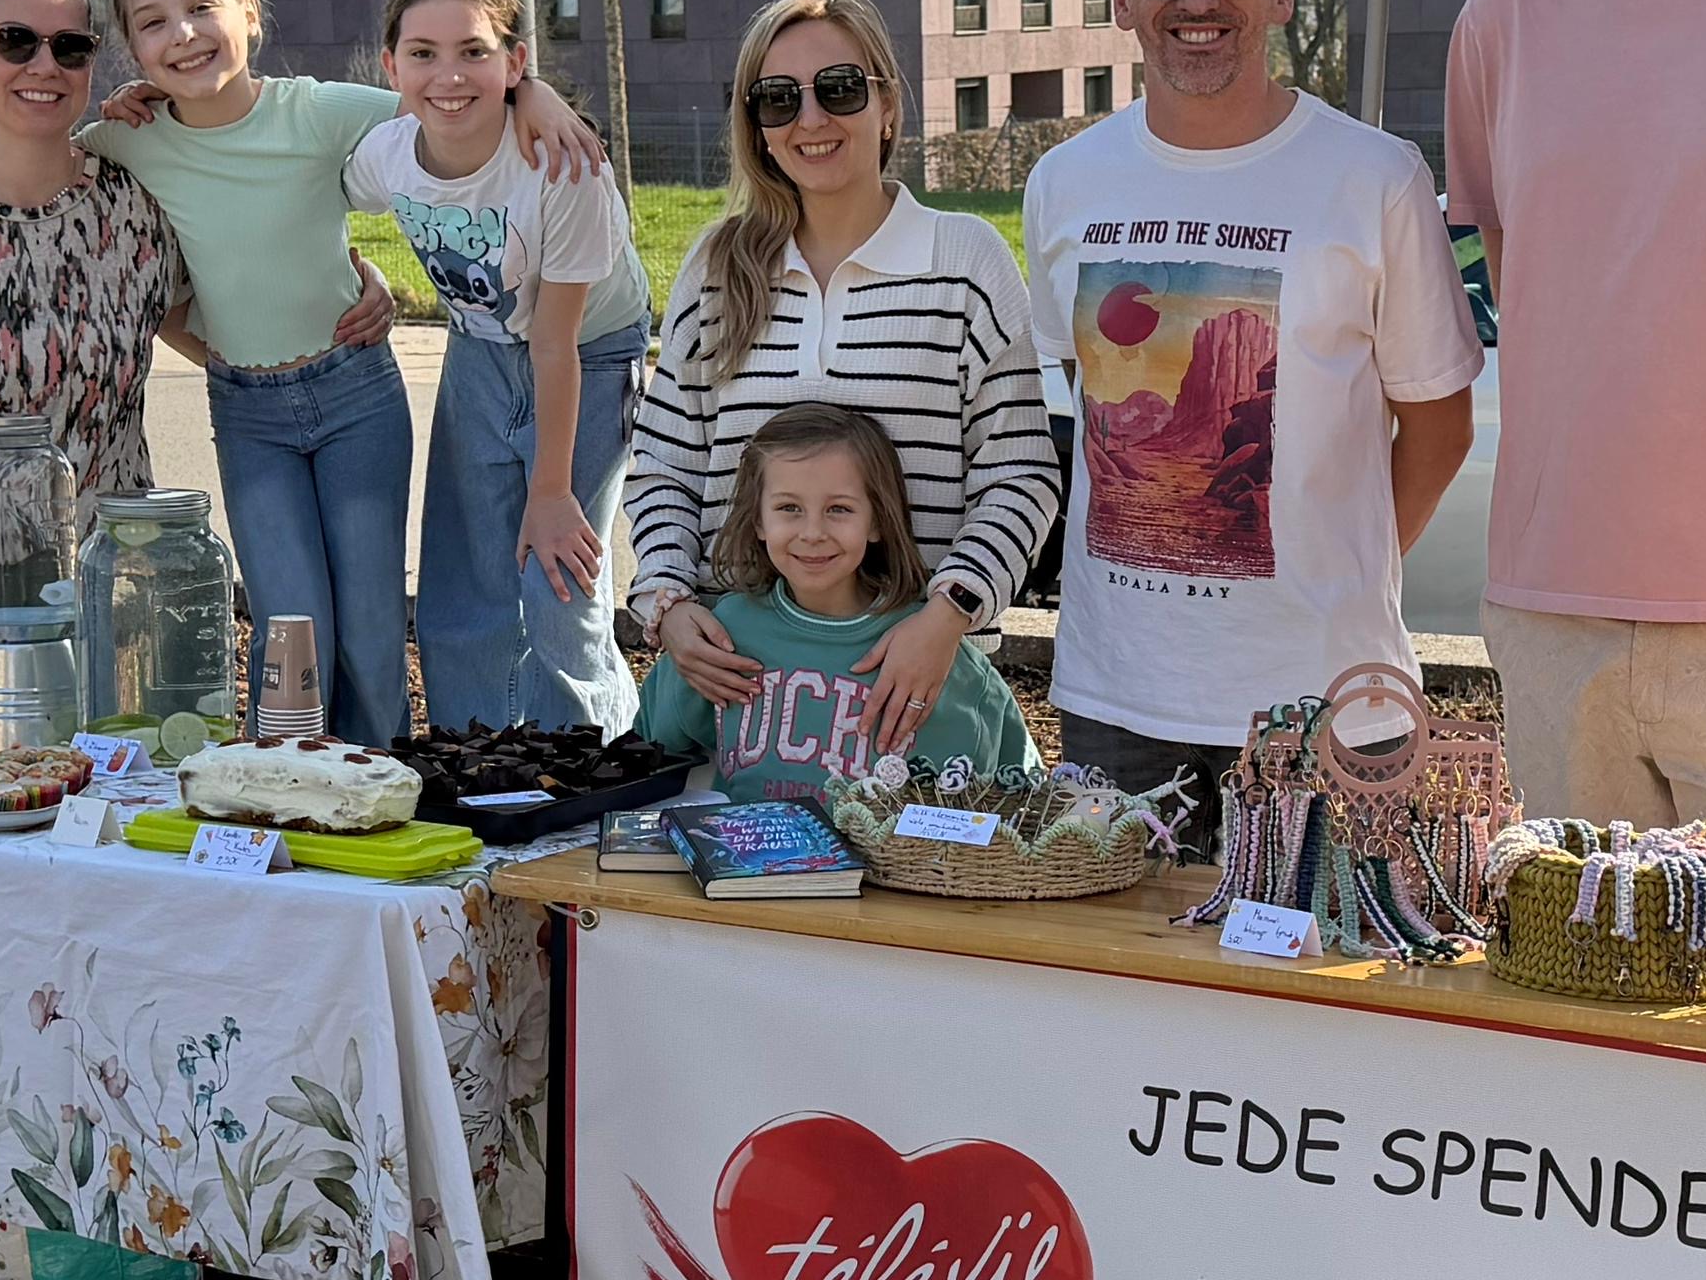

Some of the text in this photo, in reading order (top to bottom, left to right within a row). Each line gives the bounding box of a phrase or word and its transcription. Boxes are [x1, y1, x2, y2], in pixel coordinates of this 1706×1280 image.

[1082, 221, 1292, 253] RIDE INTO THE SUNSET
[1108, 571, 1230, 599] KOALA BAY
[733, 831, 801, 843] DU DICH
[741, 824, 787, 834] WENN
[1128, 1085, 1346, 1186] JEDE
